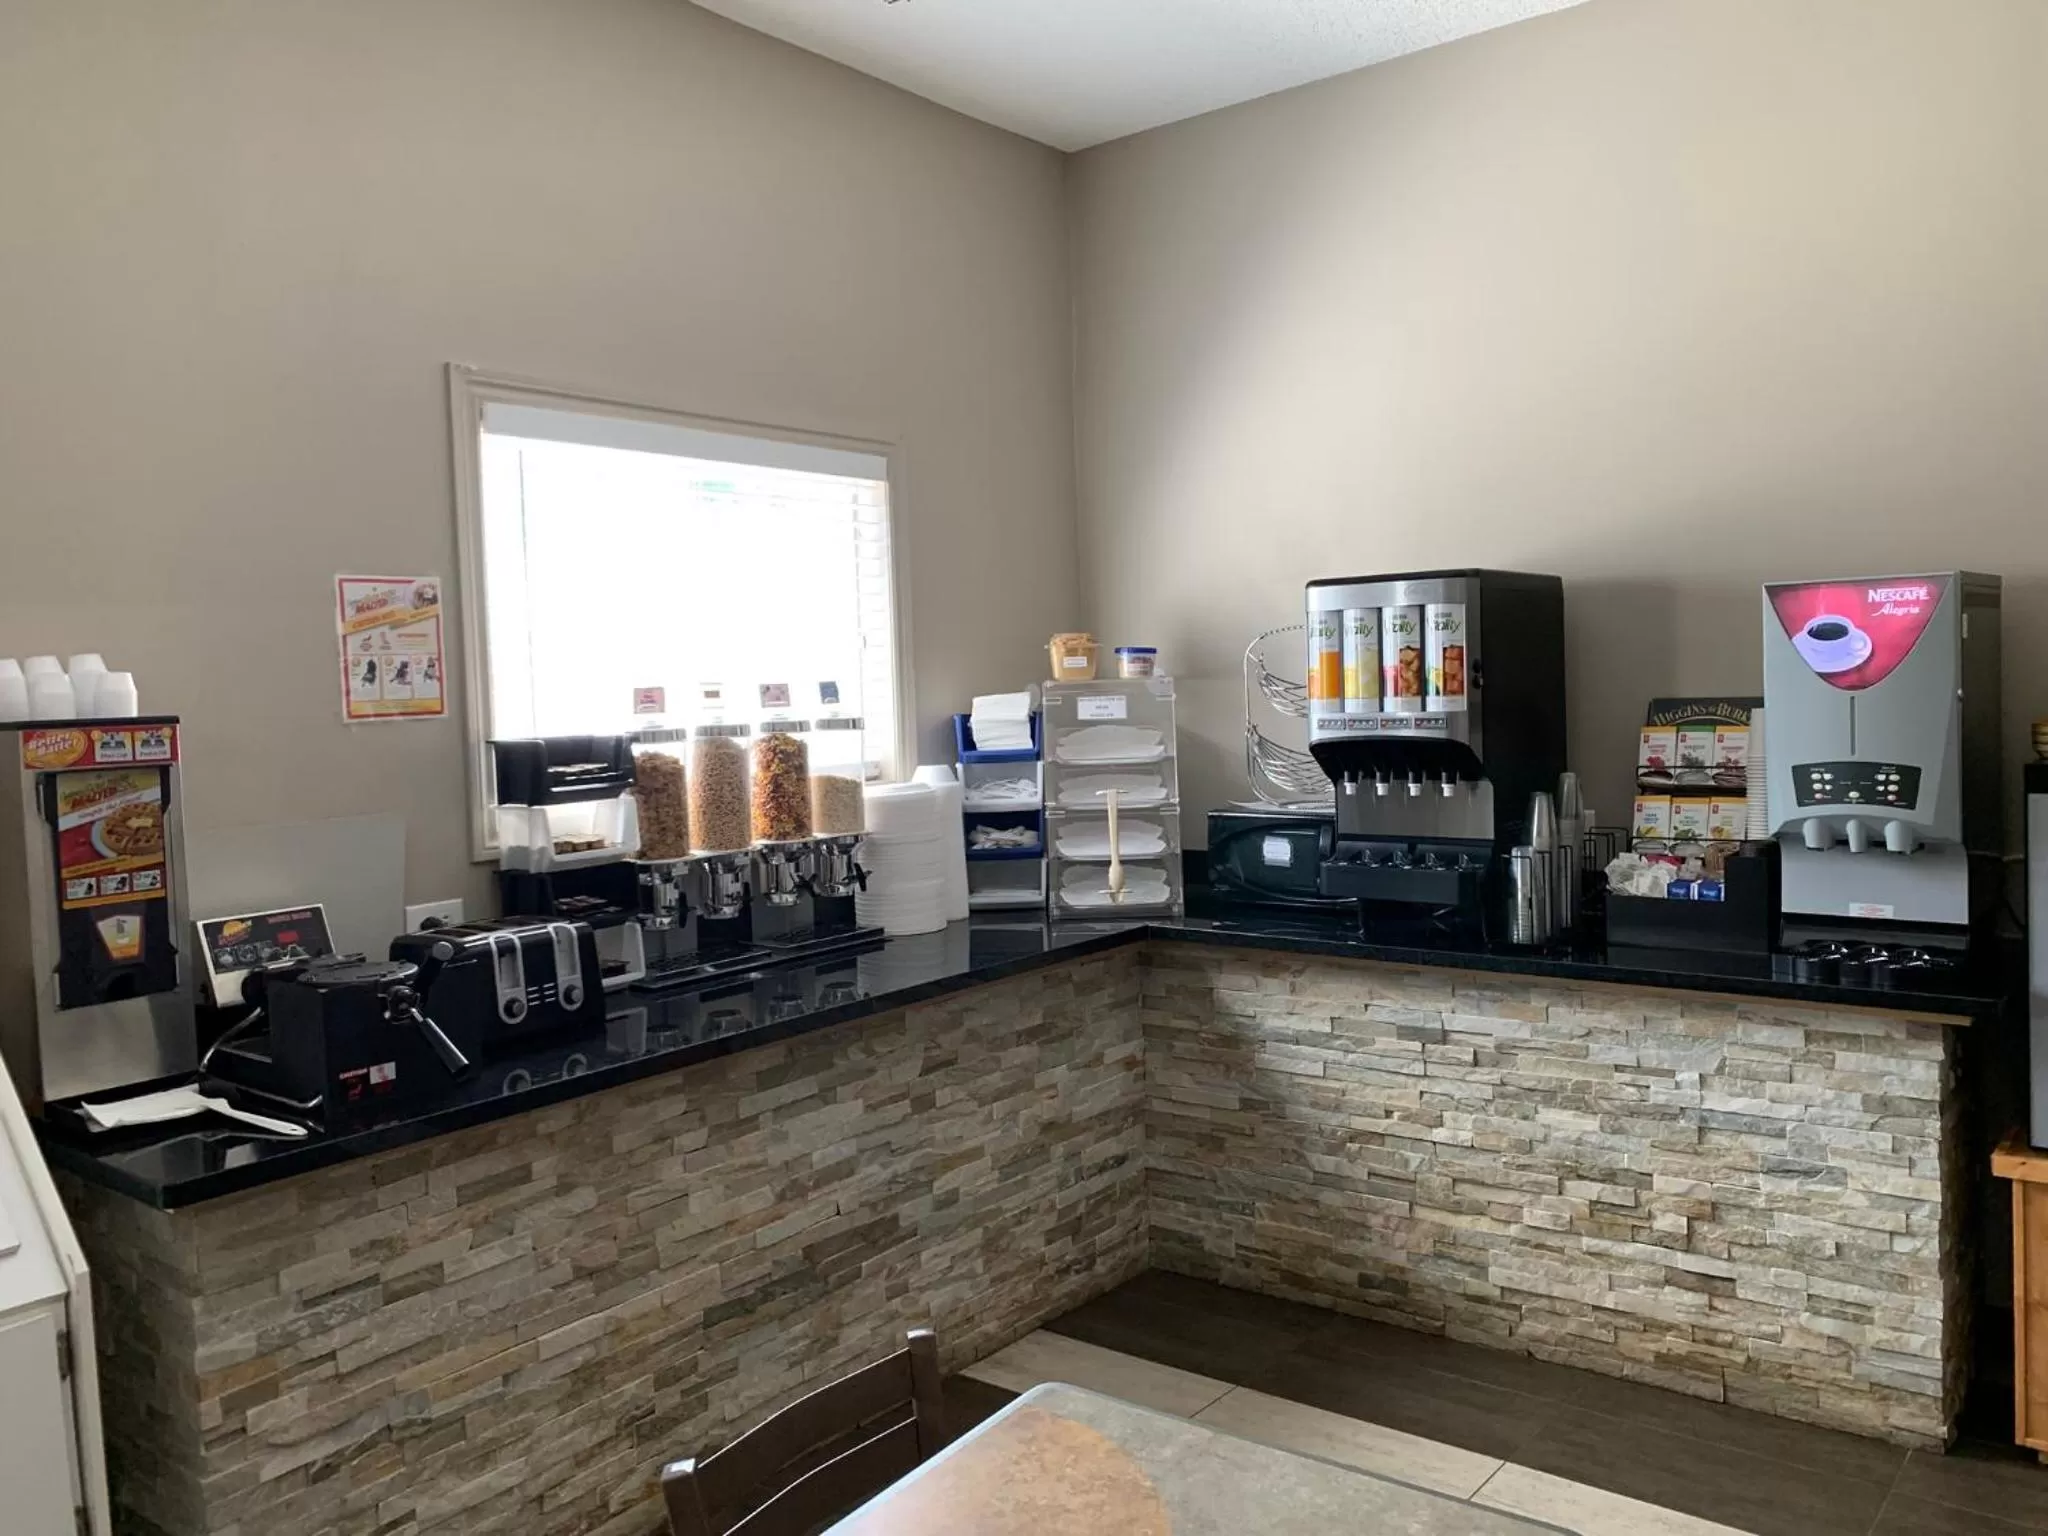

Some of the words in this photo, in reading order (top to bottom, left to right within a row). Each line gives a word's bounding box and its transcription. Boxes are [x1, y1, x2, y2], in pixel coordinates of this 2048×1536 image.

[1871, 603, 1920, 616] Alegria
[1653, 704, 1706, 725] HIGGINS
[1716, 702, 1749, 722] BURK
